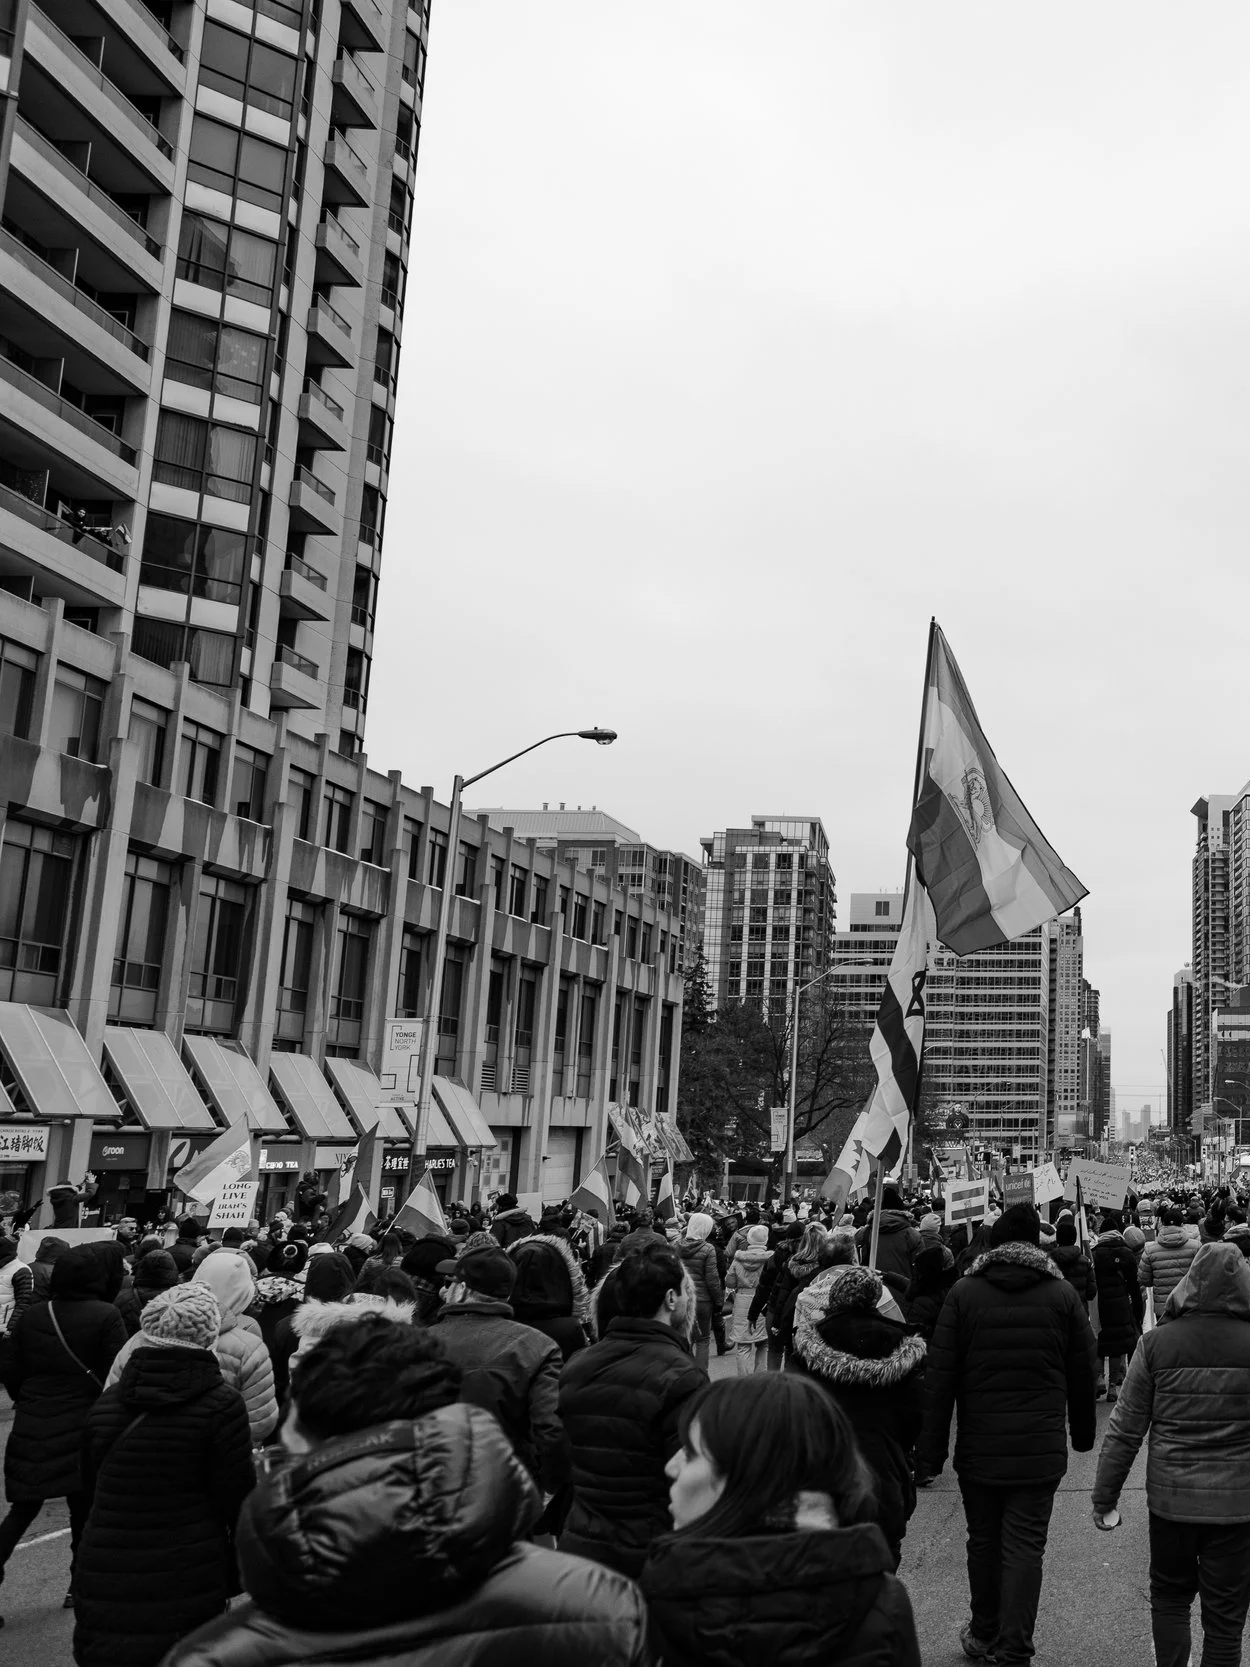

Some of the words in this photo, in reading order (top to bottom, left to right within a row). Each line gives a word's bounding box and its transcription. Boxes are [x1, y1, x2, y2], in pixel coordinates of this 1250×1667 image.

[446, 1159, 456, 1168] TEA
[222, 1192, 248, 1200] LIVE
[218, 1202, 247, 1210] IRAN'S
